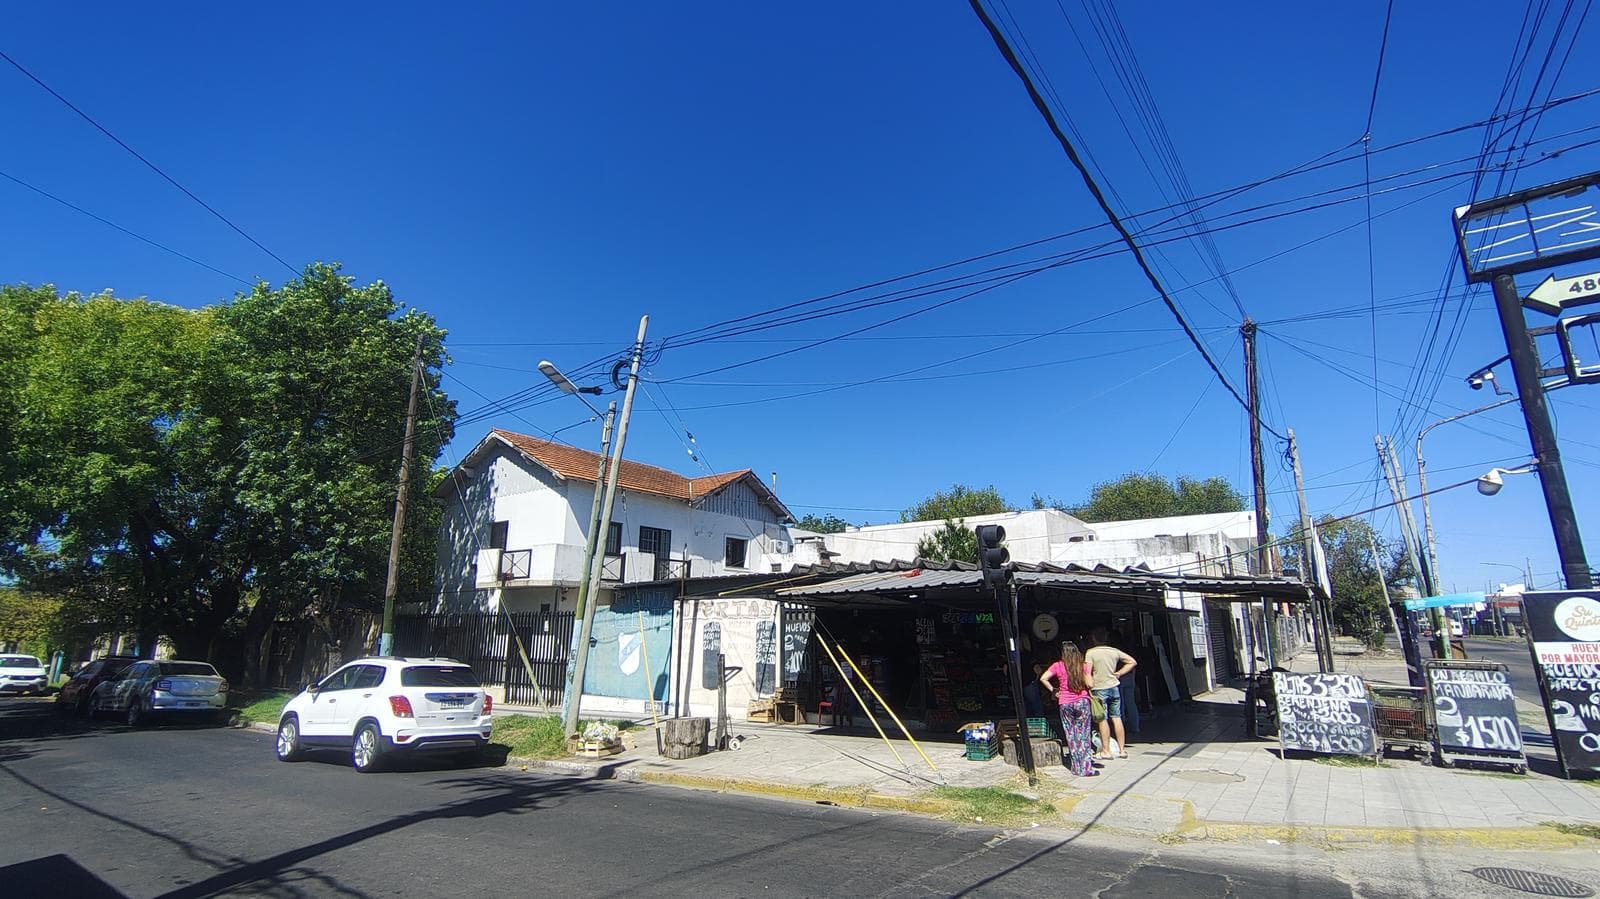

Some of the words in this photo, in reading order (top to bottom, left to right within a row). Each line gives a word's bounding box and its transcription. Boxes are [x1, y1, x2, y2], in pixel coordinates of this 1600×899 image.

[1569, 277, 1600, 292] 48
[1572, 605, 1593, 617] Su
[785, 622, 811, 633] HUEVOS
[1571, 644, 1600, 653] HUEV
[1541, 653, 1562, 663] POR
